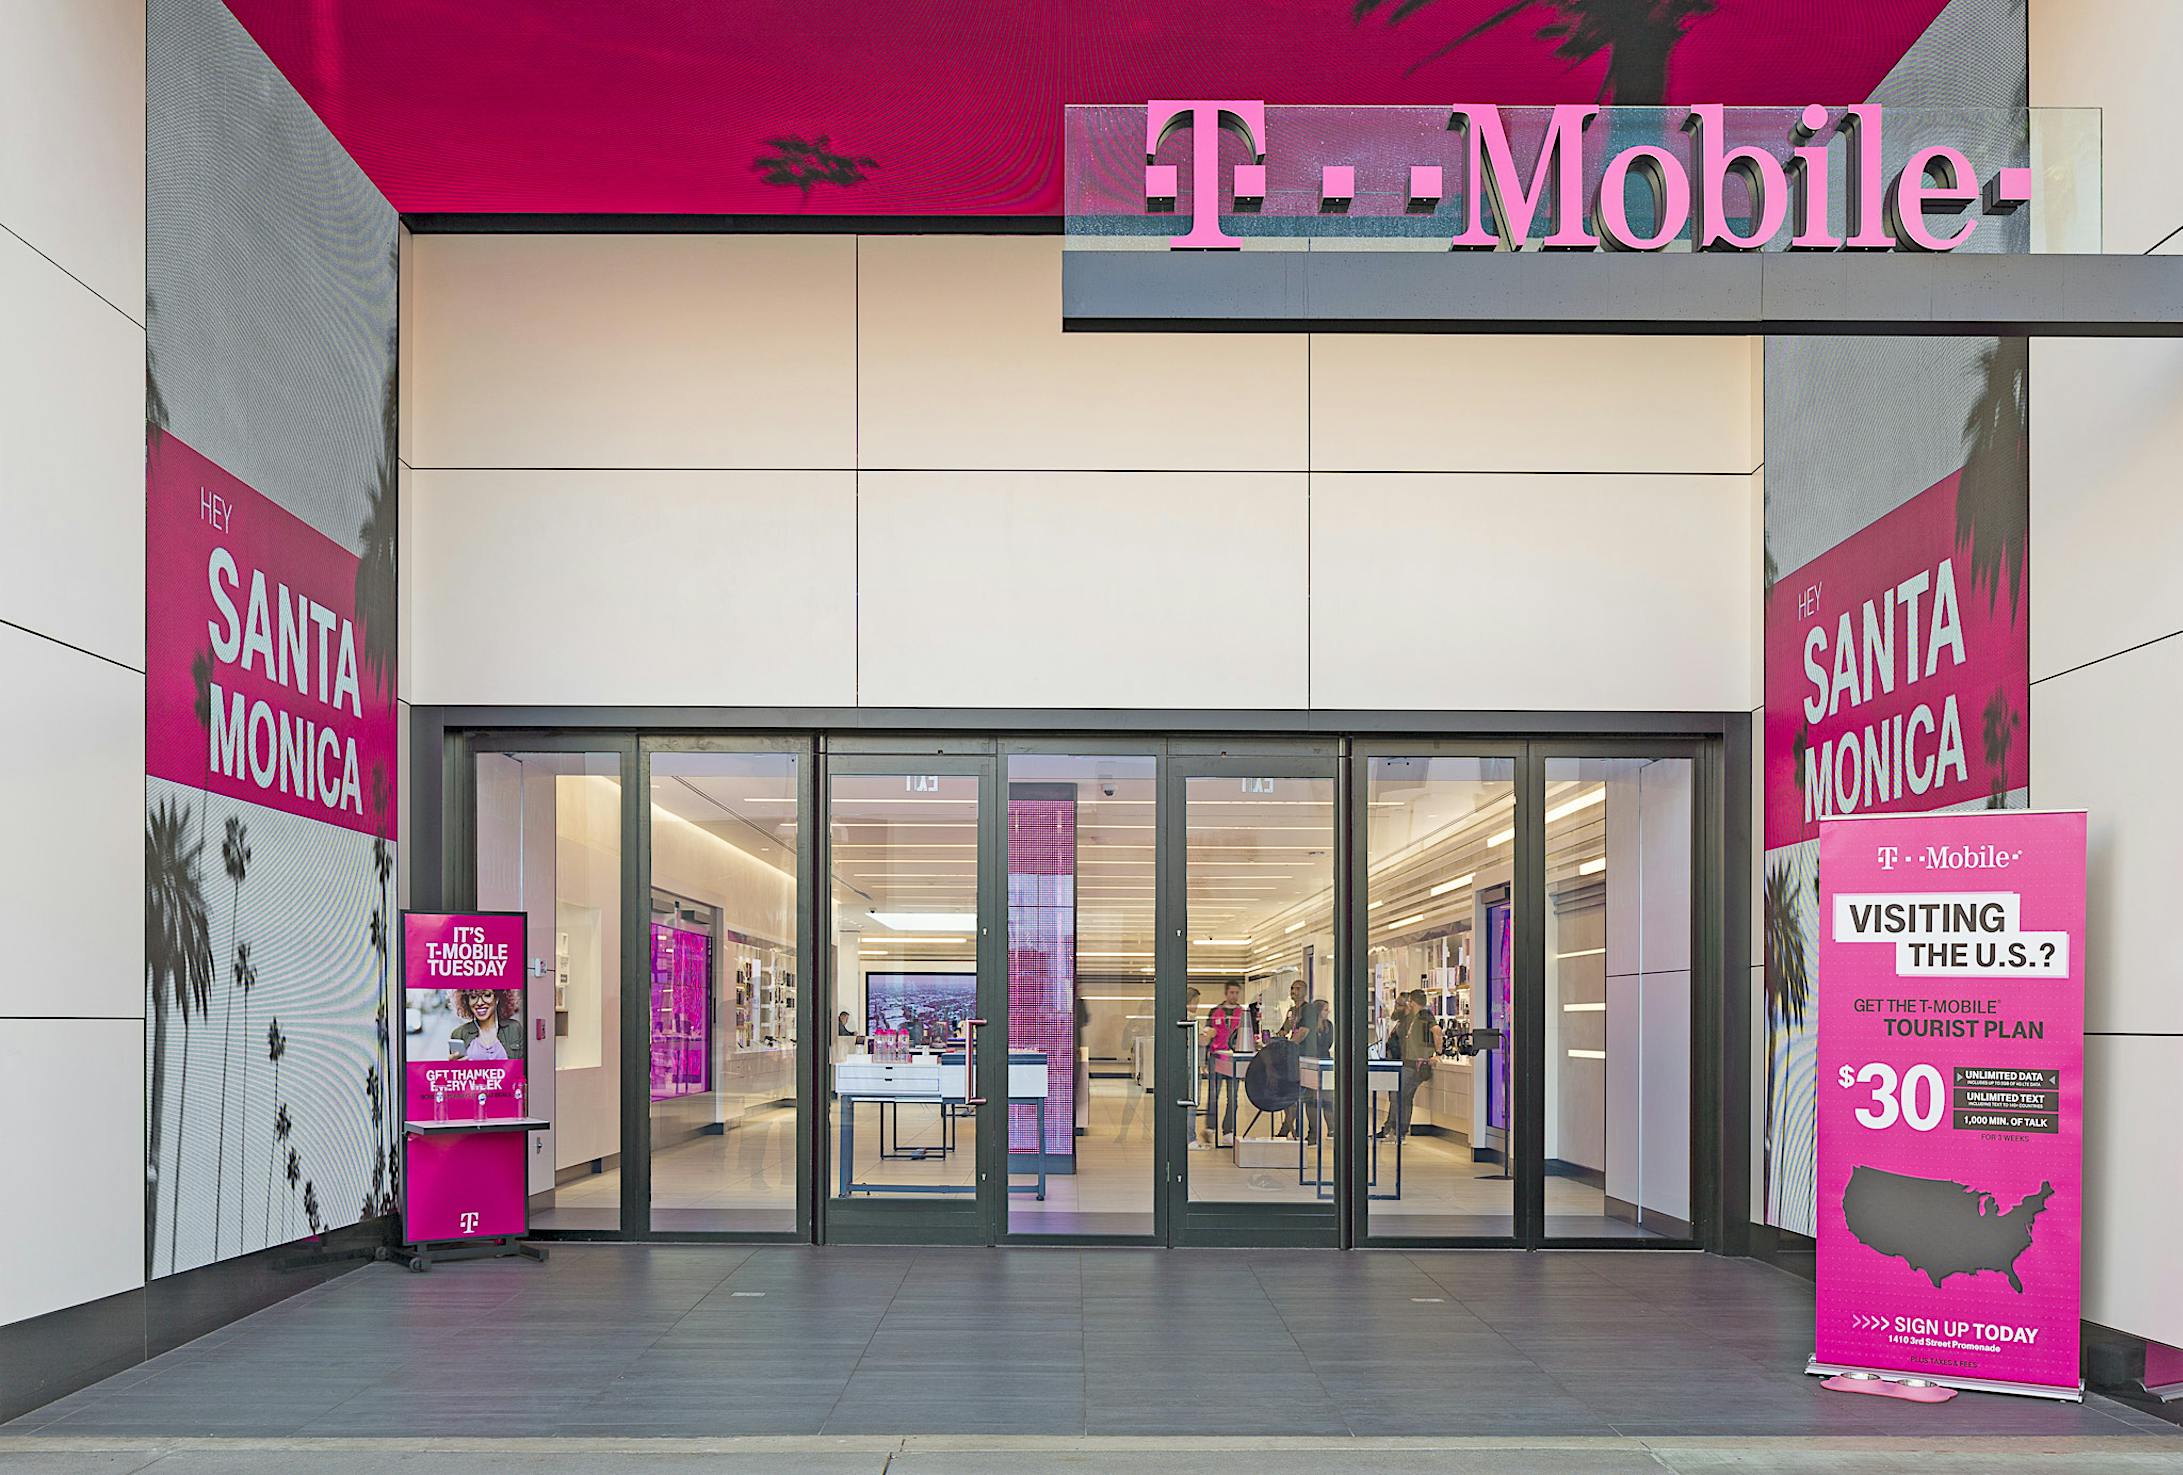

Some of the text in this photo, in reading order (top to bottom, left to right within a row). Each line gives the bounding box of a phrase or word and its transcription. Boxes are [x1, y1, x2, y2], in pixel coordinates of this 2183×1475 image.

[200, 486, 233, 534] HEY
[1798, 582, 1822, 621] HEY
[208, 547, 363, 719] SANTA
[1803, 558, 1966, 725] SANTA
[209, 682, 364, 815] MONICA
[1804, 694, 1968, 824] MONICA
[1849, 903, 2005, 933] VISITING
[453, 926, 485, 943] IT'S
[425, 942, 508, 960] T-MOBILE
[1908, 943, 2056, 967] THE U.S.?
[426, 959, 507, 977] TUESDAY
[1853, 999, 1998, 1014] GET THE T-MOBILE
[1884, 1018, 2044, 1039] TOURIST PLAN
[451, 1068, 505, 1080] THANKED
[1965, 1070, 2044, 1082] UNLIMITED DATA
[1837, 1062, 1946, 1132] $30
[1967, 1092, 2045, 1104] UNLIMITED TEXT
[1964, 1115, 2048, 1128] 1,000 MIN. OF TALK
[1981, 1133, 1997, 1141] FOR
[459, 1212, 480, 1234] T
[1894, 1316, 2038, 1344] SIGN UP TODAY
[1889, 1335, 2001, 1353] 1410 3rd Street Promenade
